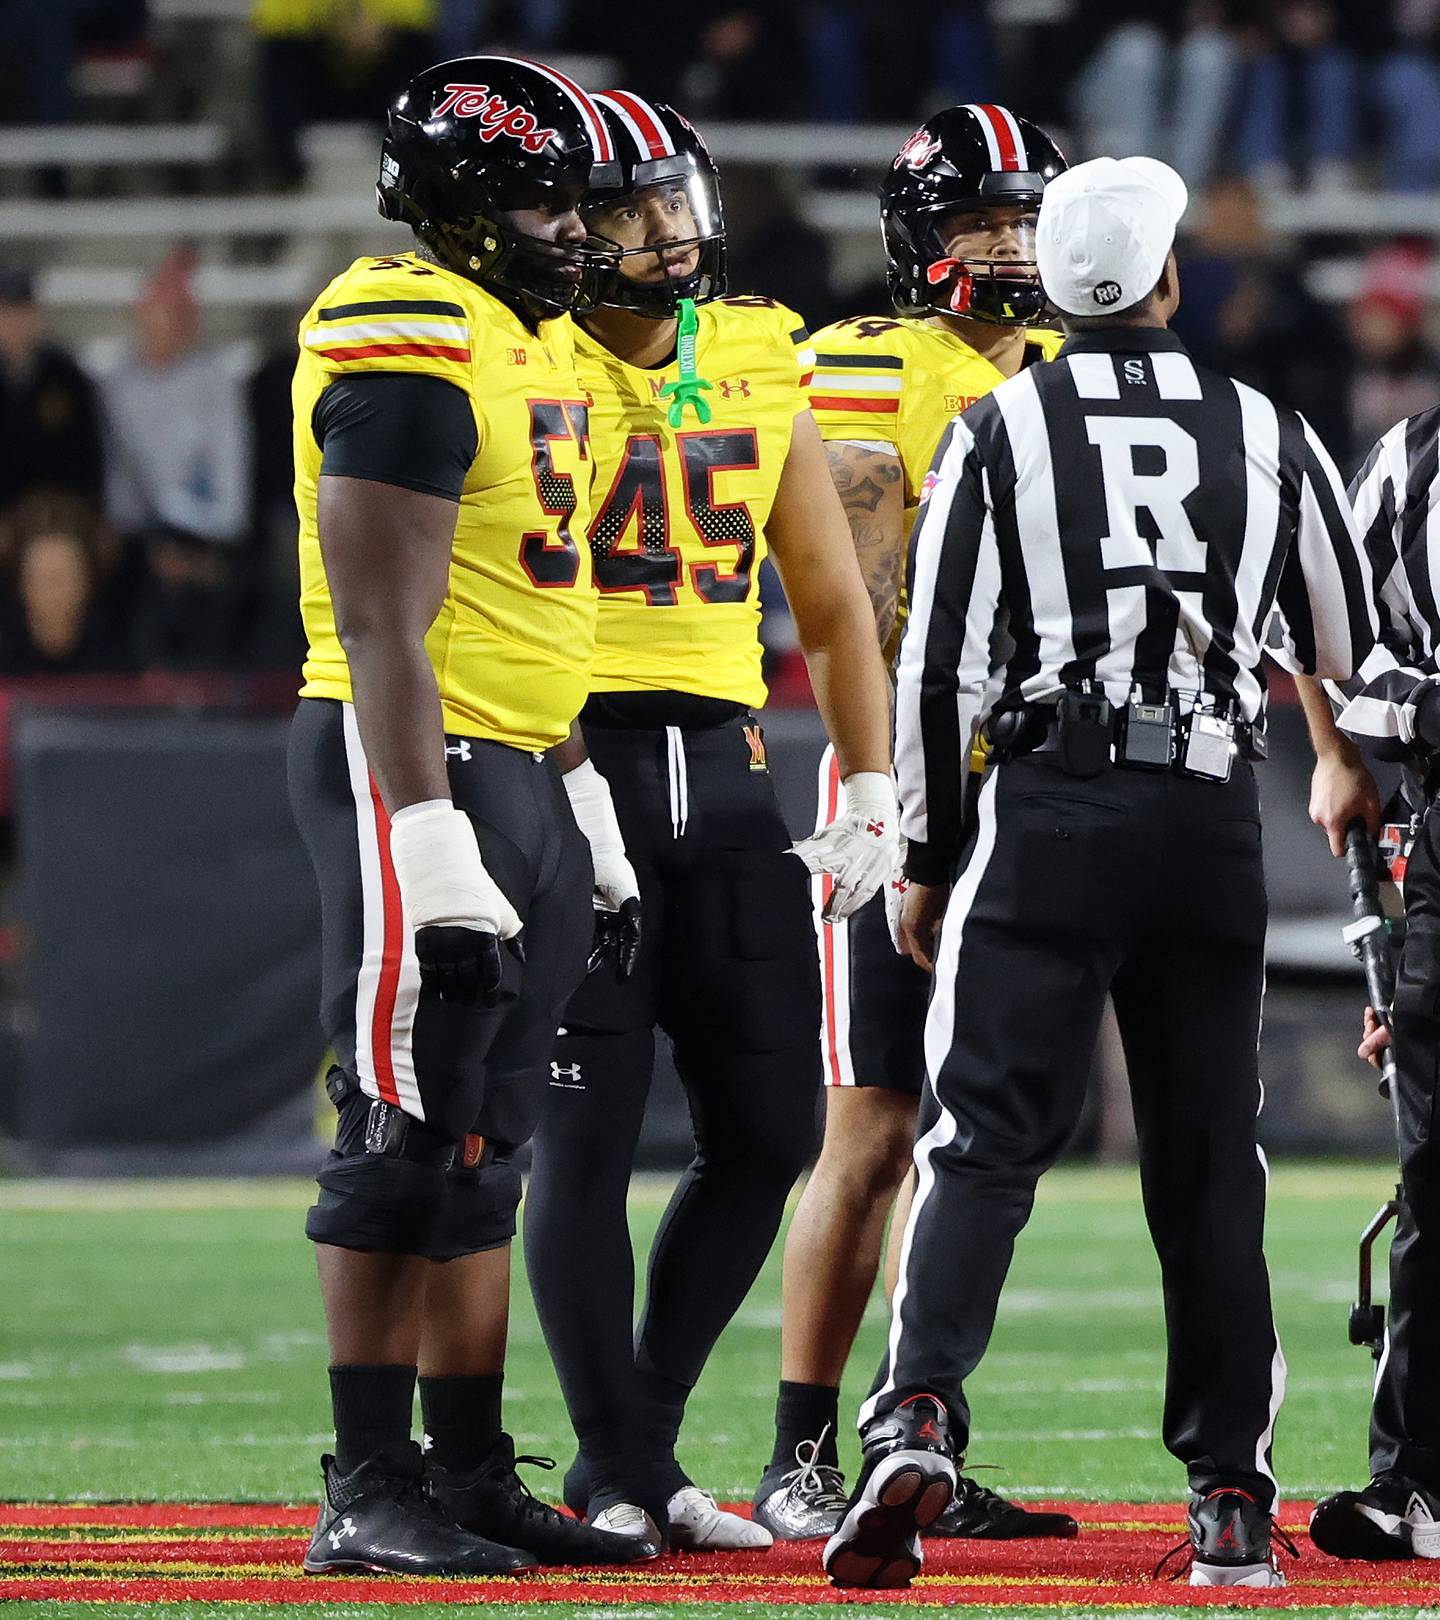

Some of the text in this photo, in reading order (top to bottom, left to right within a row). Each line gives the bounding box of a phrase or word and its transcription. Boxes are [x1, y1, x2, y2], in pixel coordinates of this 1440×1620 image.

[433, 83, 555, 154] Terps
[1095, 283, 1121, 303] RR
[681, 334, 695, 374] NXTRND
[585, 426, 762, 607] 45
[1084, 415, 1209, 574] R
